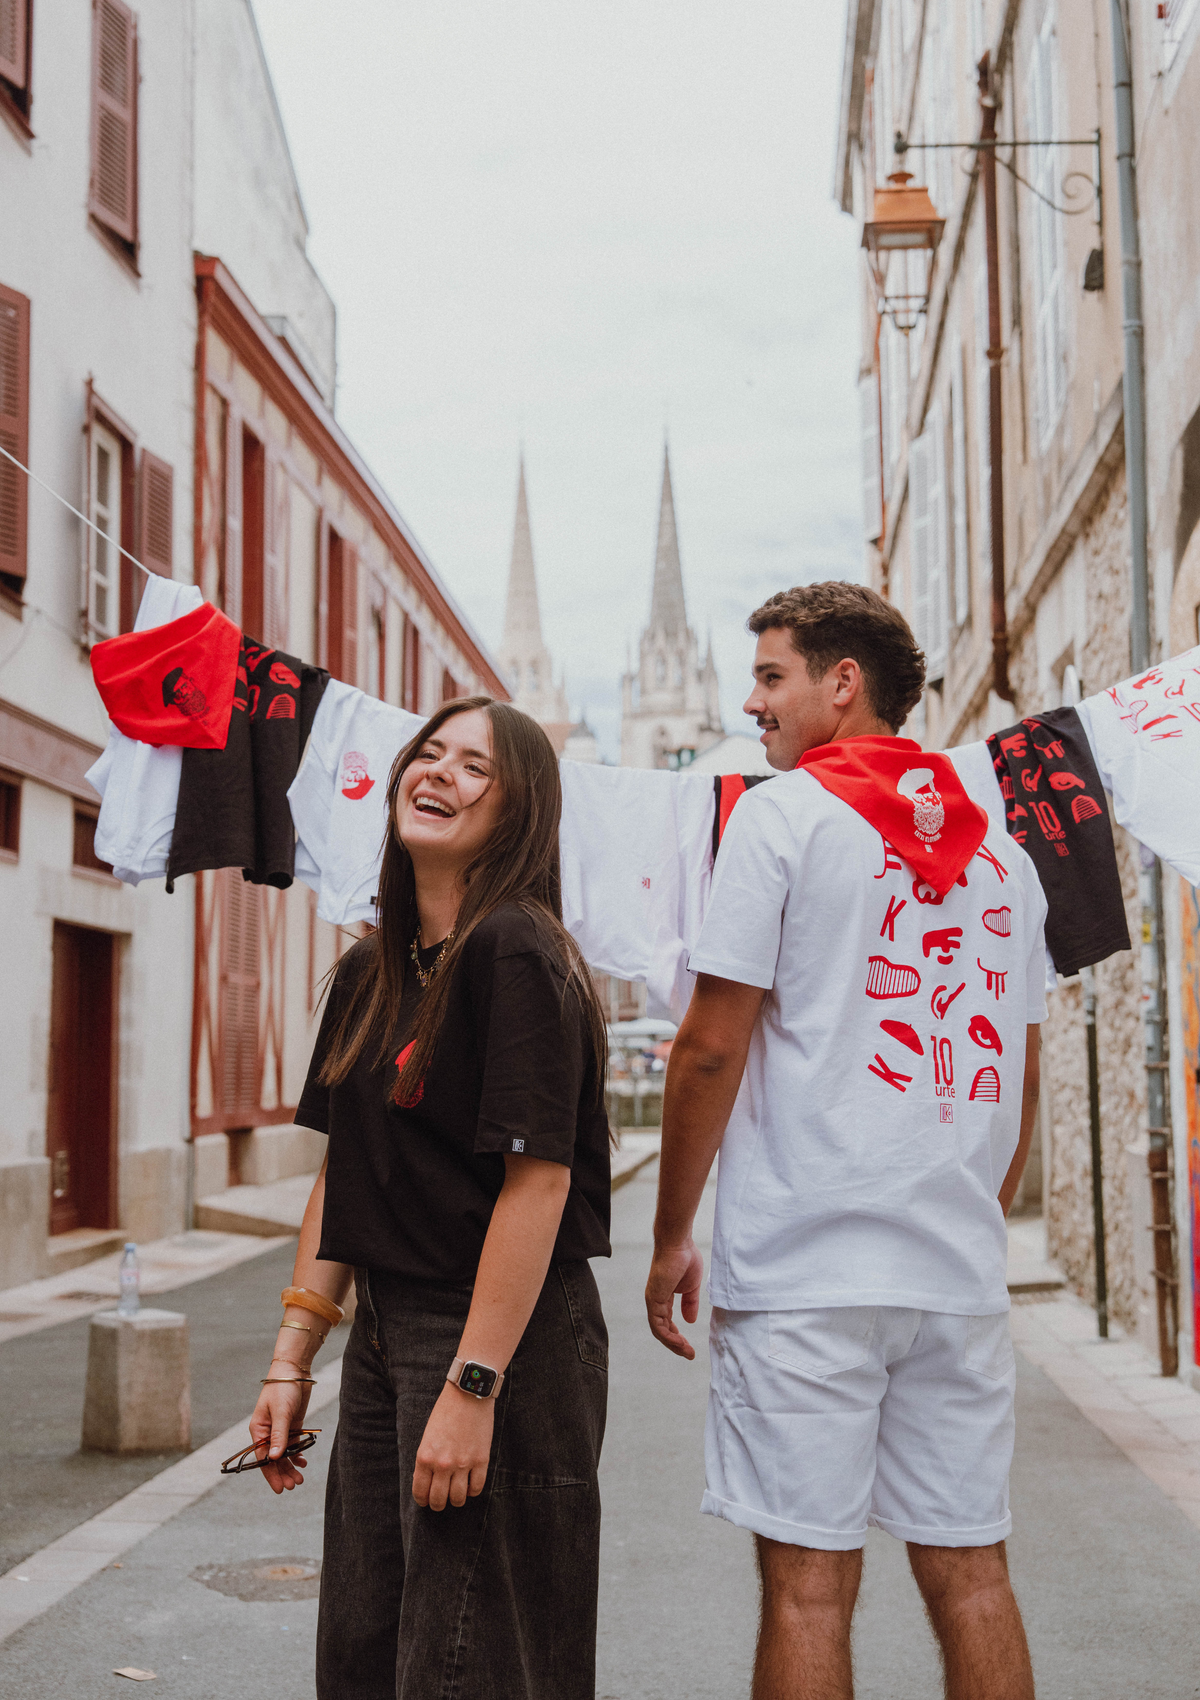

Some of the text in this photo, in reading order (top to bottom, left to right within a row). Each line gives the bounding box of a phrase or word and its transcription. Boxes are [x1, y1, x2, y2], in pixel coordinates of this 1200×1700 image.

[1028, 801, 1061, 834] 10
[931, 1035, 954, 1086] 10
[935, 1084, 956, 1099] urte
